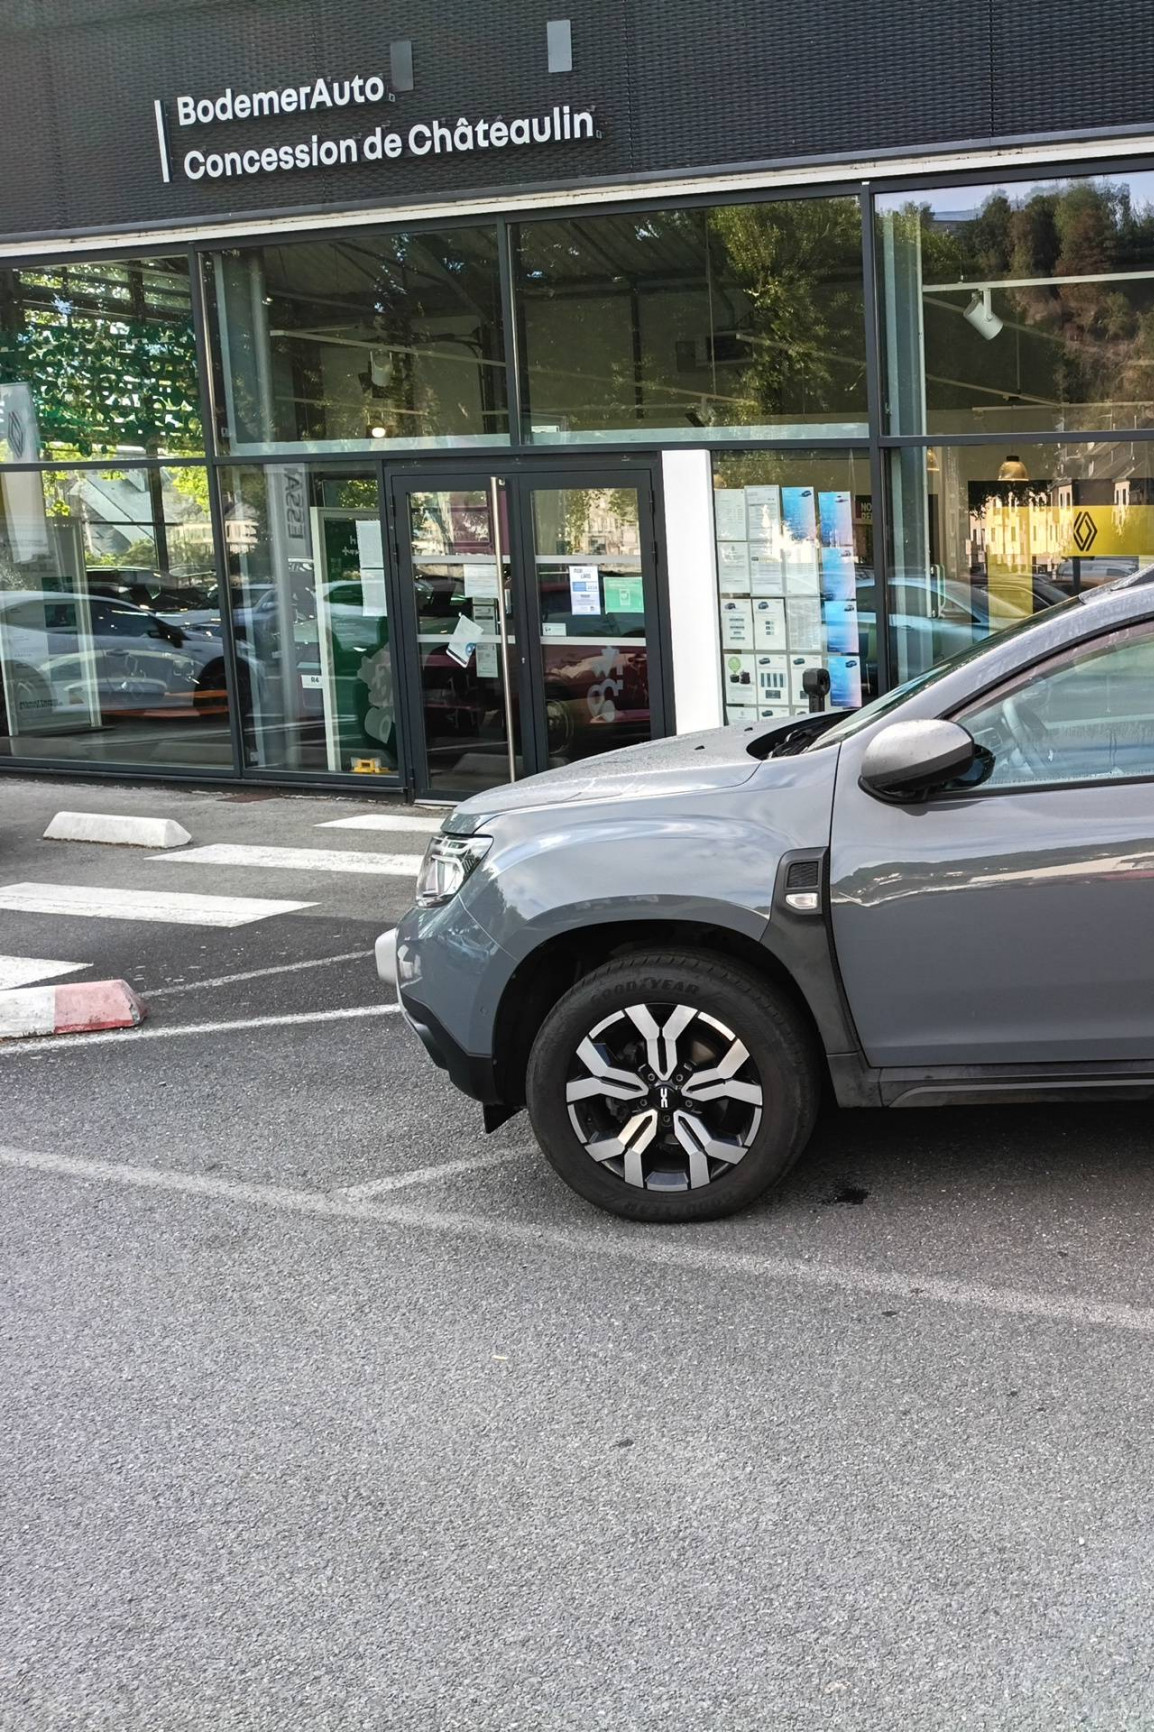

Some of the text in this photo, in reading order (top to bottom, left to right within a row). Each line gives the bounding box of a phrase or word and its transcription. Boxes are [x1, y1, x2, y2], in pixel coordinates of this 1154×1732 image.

[177, 75, 384, 126] BodemerAuto
[184, 105, 594, 180] Concession de Châteaulin
[590, 976, 700, 1003] GOODYEAR
